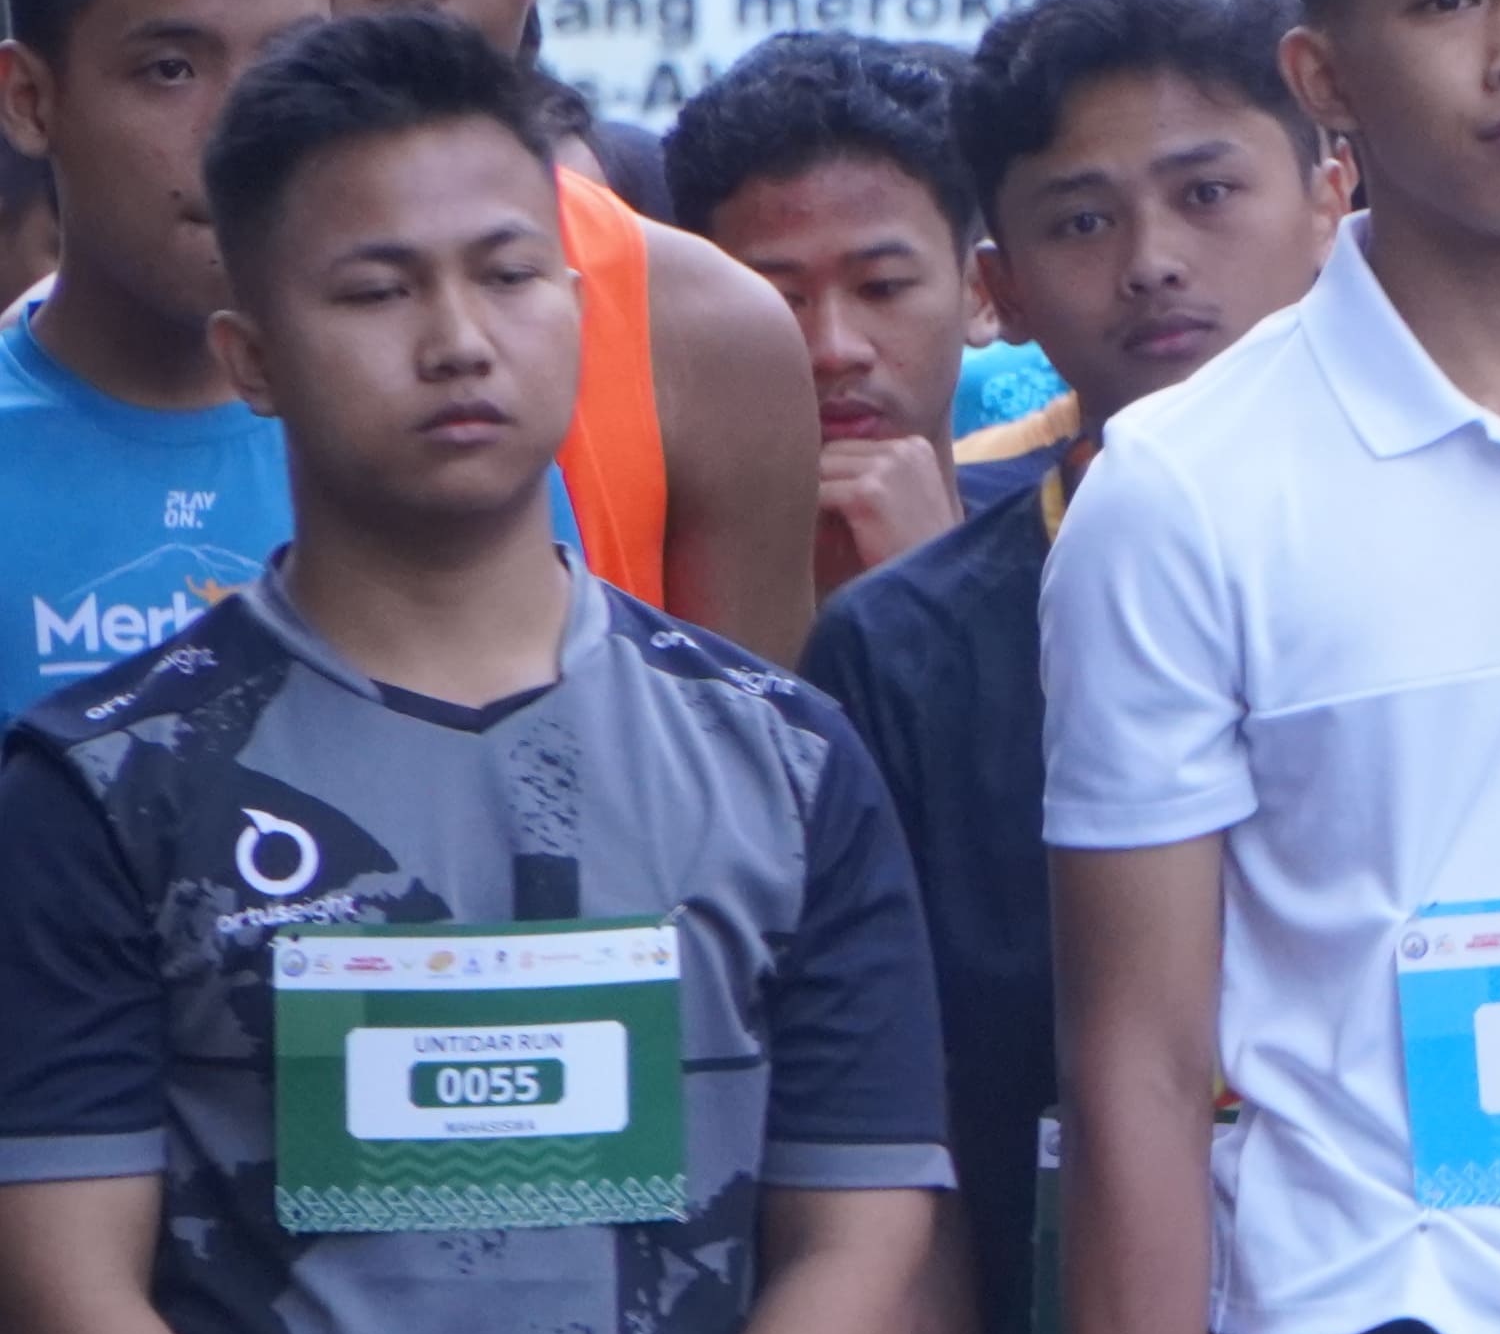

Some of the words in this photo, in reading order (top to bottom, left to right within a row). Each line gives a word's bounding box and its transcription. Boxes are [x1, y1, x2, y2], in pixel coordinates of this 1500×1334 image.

[167, 491, 216, 510] PLAY
[413, 1034, 514, 1054] UNTIDAR
[518, 1031, 564, 1051] RUN
[436, 1066, 540, 1104] 0055
